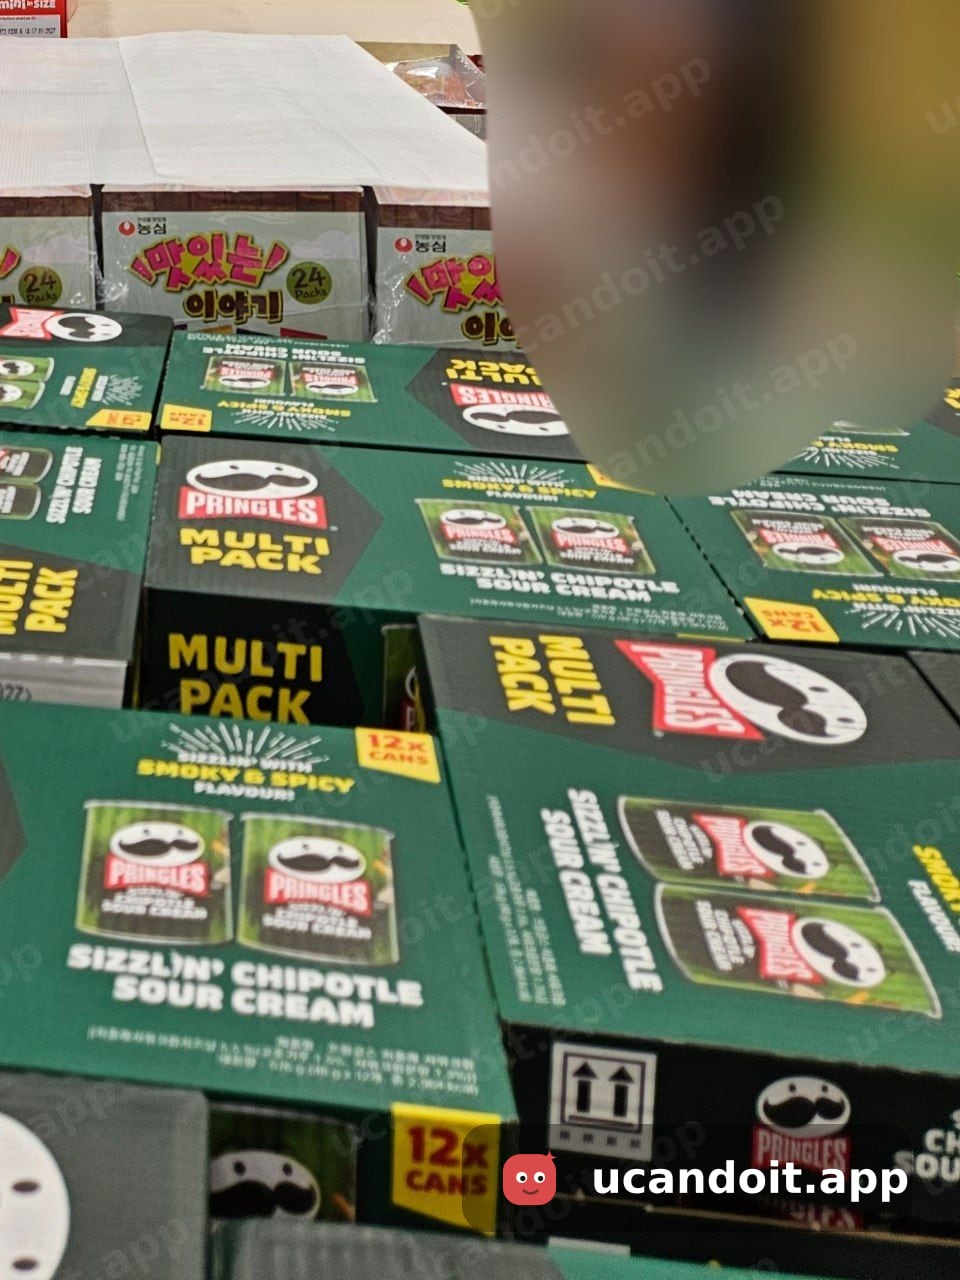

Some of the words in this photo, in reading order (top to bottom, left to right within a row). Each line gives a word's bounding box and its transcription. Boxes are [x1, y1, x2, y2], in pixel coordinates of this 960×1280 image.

[33, 0, 56, 8] SIZE
[136, 222, 167, 235] 농심
[146, 233, 268, 290] 맛있는
[415, 239, 447, 253] 농심
[25, 272, 57, 294] 24
[292, 268, 325, 292] 24
[294, 289, 328, 301] Packs
[26, 291, 58, 305] Packs
[186, 290, 283, 323] 이야기
[442, 477, 516, 492] SMOKY
[540, 485, 597, 499] SPICY
[185, 490, 319, 526] PRINGLES
[179, 527, 331, 557] MULTI
[189, 546, 323, 575] PACK
[476, 576, 551, 595] SOUR
[555, 582, 652, 603] CREAM
[550, 571, 681, 594] CHIPOTLE
[24, 566, 79, 633] PACK
[168, 632, 323, 683] MULTI
[489, 635, 556, 715] PACK
[538, 634, 616, 726] MULTI
[179, 679, 312, 726] PACK
[367, 732, 429, 753] 12x
[369, 749, 432, 767] CANS
[137, 758, 239, 783] SMOKY
[243, 767, 266, 786] &
[270, 771, 355, 794] SPICY
[259, 756, 313, 774] WITH
[193, 781, 295, 801] FLAVOUR!
[541, 808, 585, 869] SOUR
[108, 859, 207, 895] PRINGLES
[567, 787, 622, 873] SIZZLIN'
[596, 873, 664, 994] CHIPOTLE
[268, 874, 370, 916] PRINGLES
[559, 868, 613, 956] CREAM
[67, 943, 225, 983] SIZZLIN'
[230, 960, 424, 1008] CHIPOTLE
[112, 975, 224, 1012] SOUR
[230, 989, 375, 1029] CREAM
[407, 1123, 489, 1170] 12x
[405, 1168, 488, 1197] CANS
